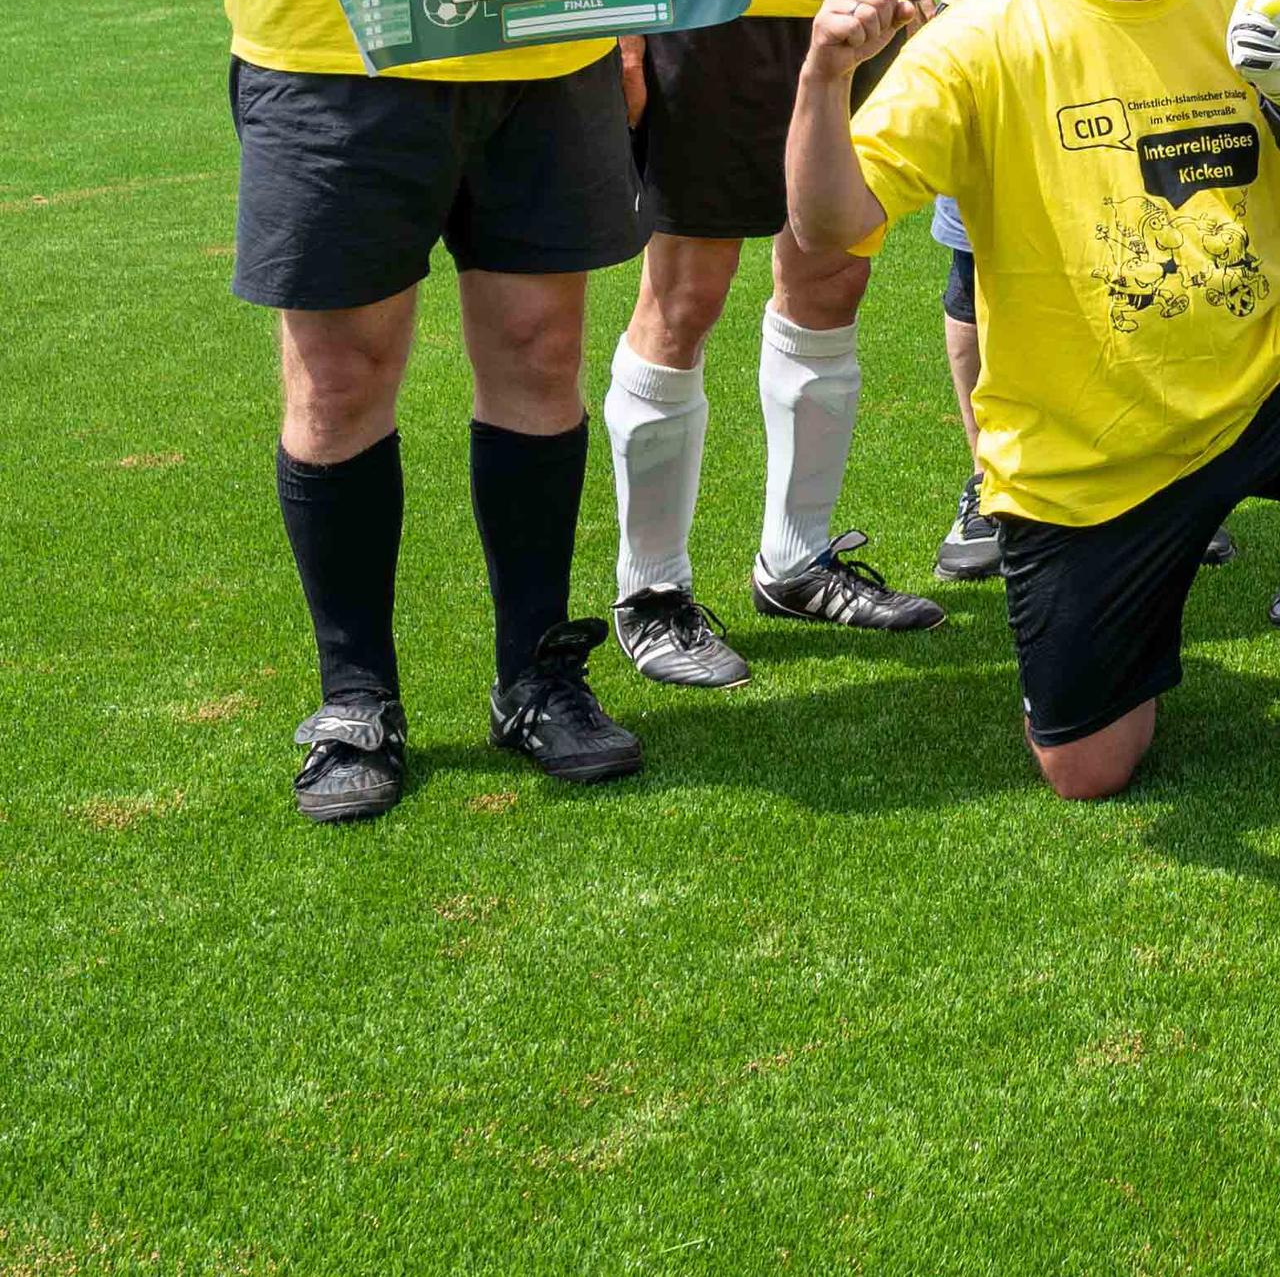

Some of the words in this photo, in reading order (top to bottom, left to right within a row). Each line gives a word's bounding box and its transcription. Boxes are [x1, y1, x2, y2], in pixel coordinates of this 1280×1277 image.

[1127, 90, 1224, 112] Christlich-Islamischer
[1224, 88, 1247, 102] Dialog
[1150, 115, 1164, 126] im
[1165, 111, 1191, 125] Kreis
[1191, 105, 1237, 120] Bergstraße
[1074, 115, 1114, 141] CID
[1143, 132, 1254, 162] Interreligiöses
[1178, 162, 1234, 185] Kicken
